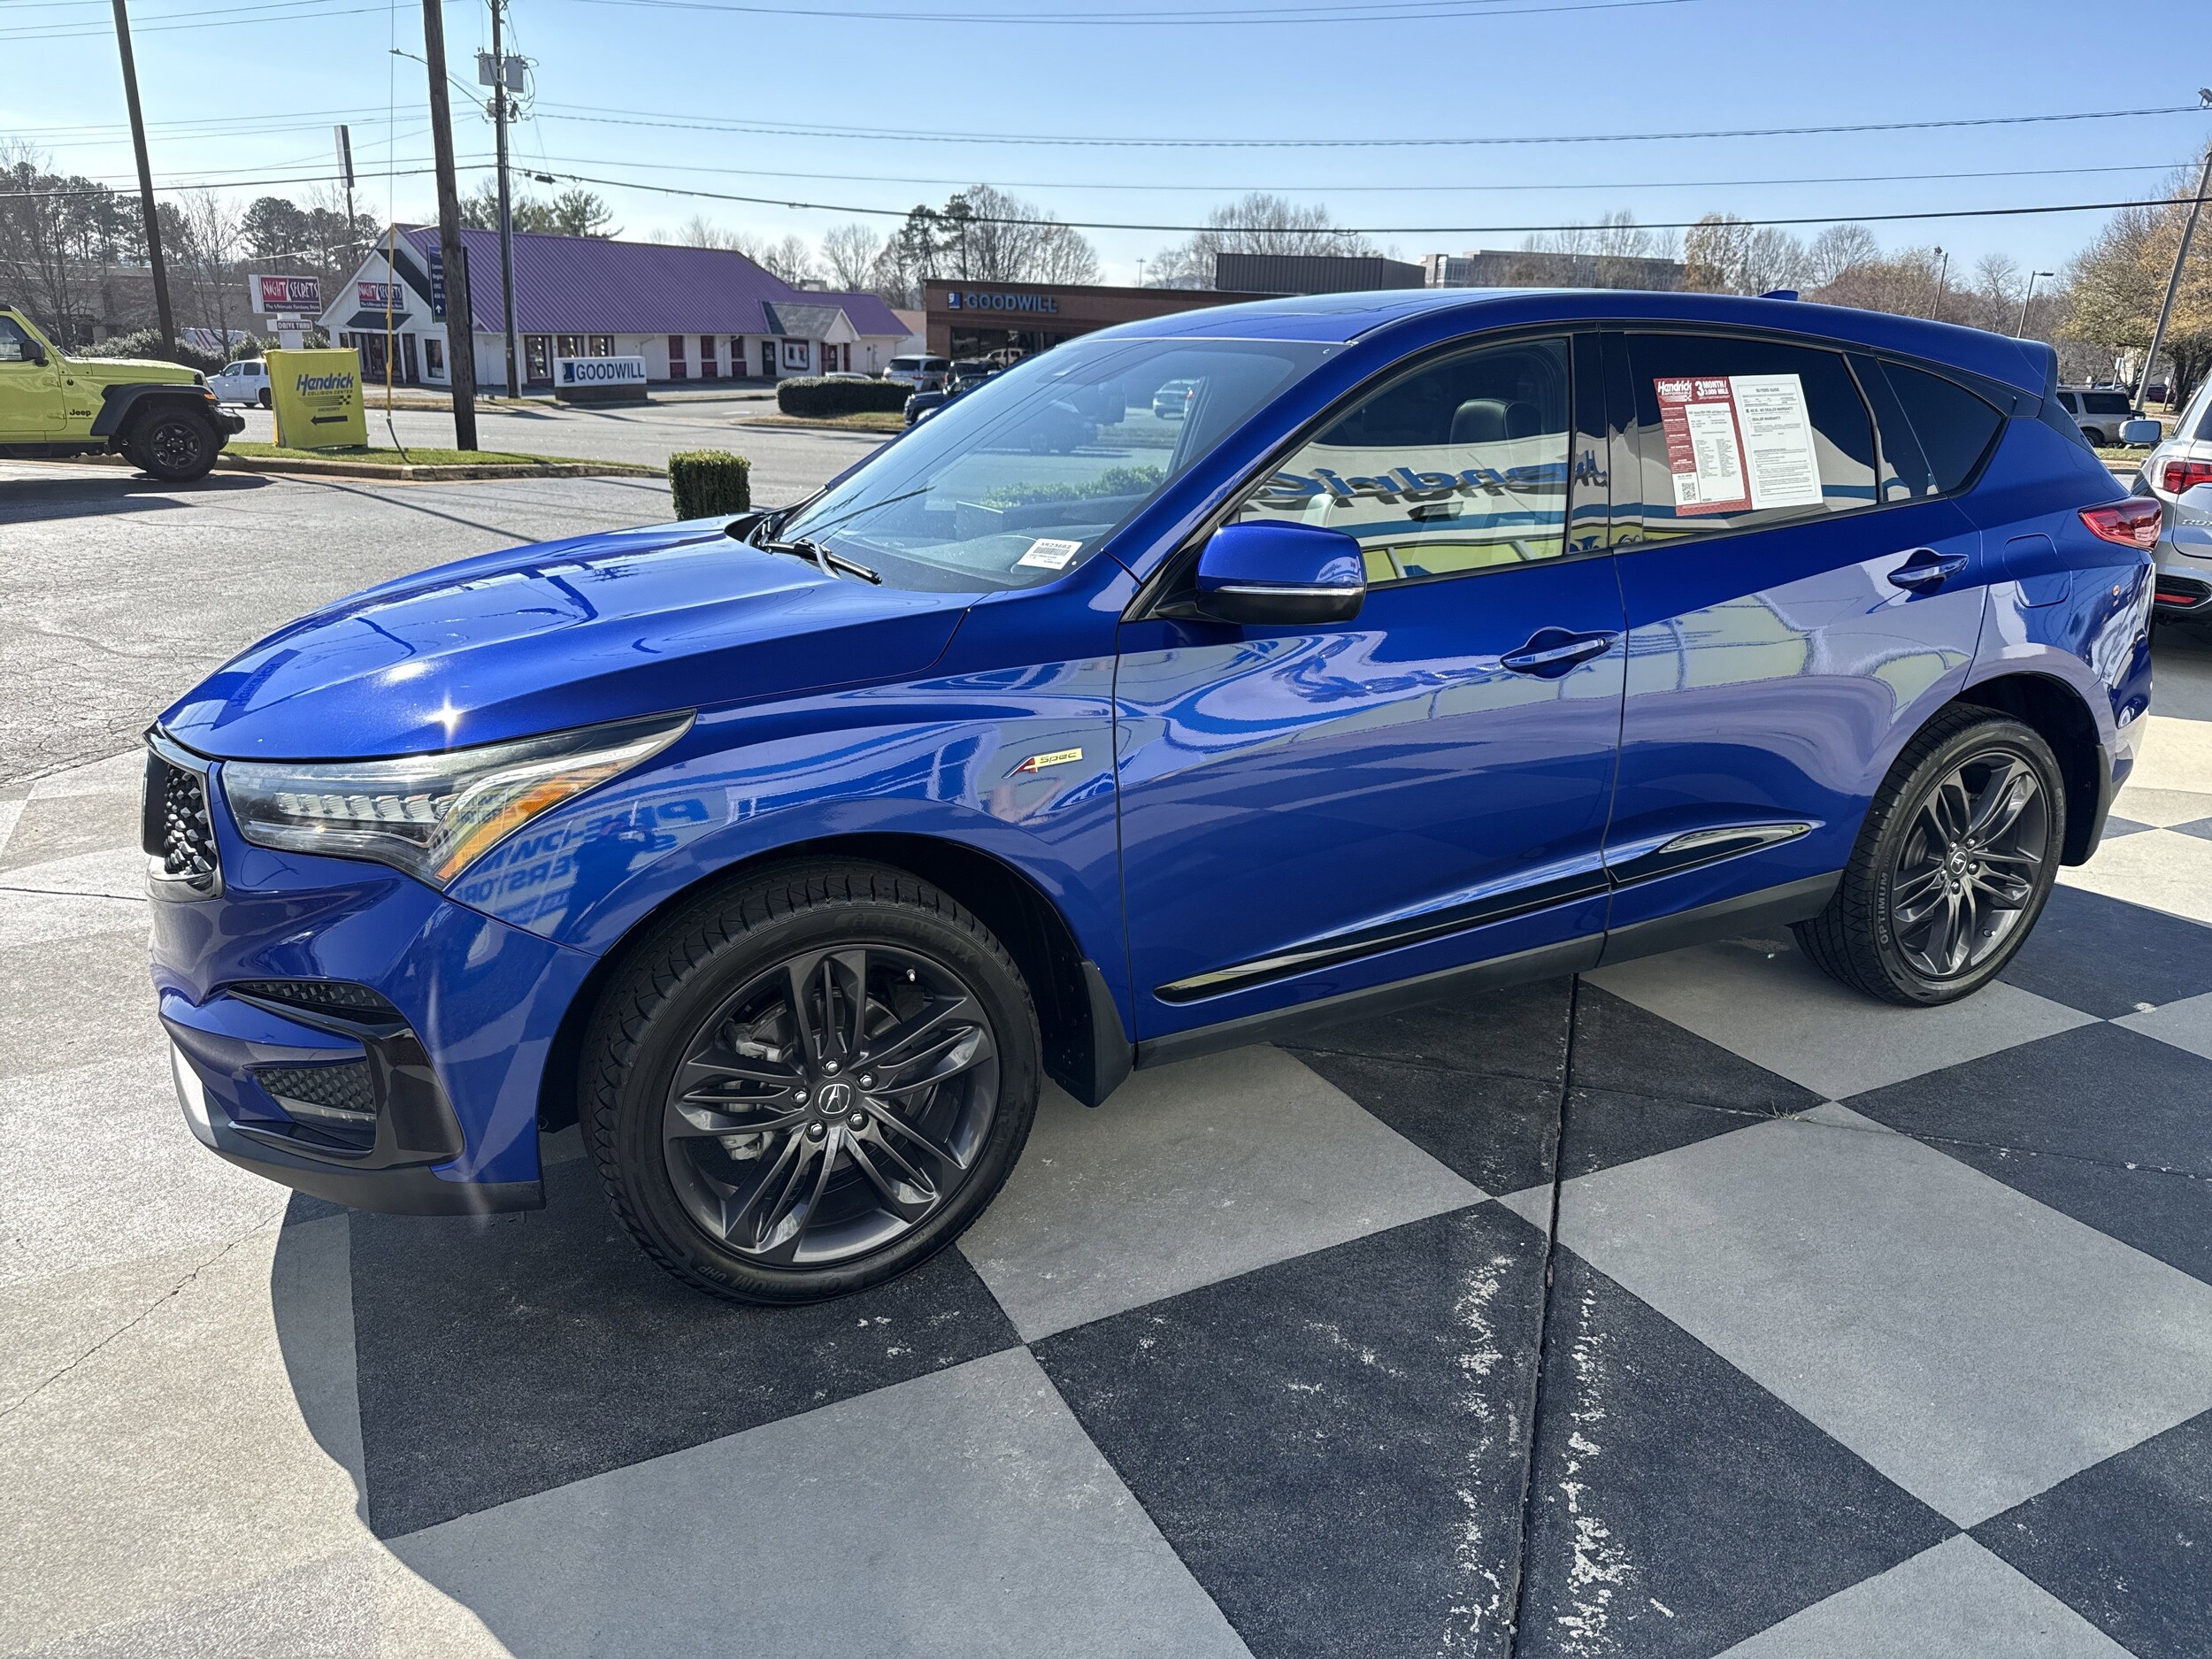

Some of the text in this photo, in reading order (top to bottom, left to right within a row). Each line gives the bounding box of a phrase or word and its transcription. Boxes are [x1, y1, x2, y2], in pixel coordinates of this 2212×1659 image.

[289, 281, 319, 298] SECRETS
[965, 292, 1057, 313] GOODWILL
[576, 362, 645, 380] GOODWILL
[296, 373, 354, 396] Hendrick
[1657, 380, 1693, 396] Hendrick
[1695, 381, 1705, 396] 3
[1878, 872, 1889, 944] OPTIMUM
[698, 1264, 728, 1283] UHP
